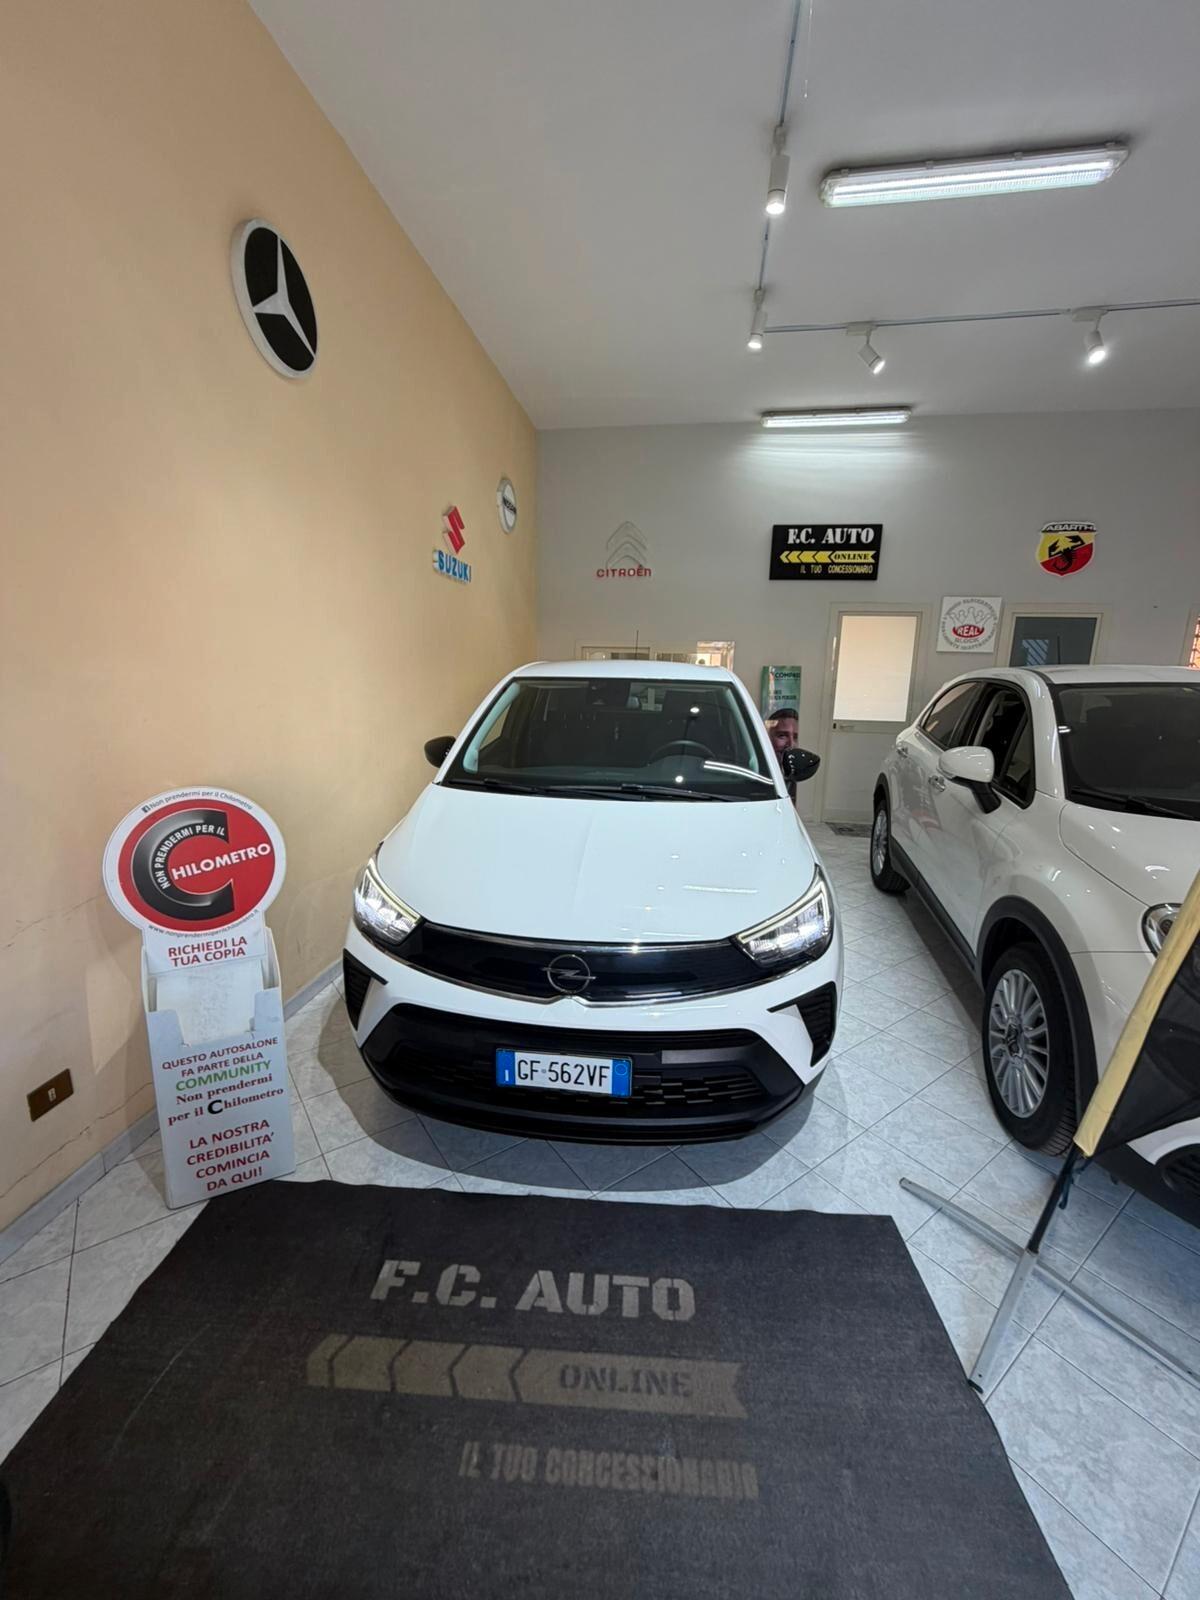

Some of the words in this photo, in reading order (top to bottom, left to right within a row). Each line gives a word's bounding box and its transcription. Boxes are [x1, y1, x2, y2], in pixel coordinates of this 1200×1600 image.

[787, 528, 815, 544] F.C.
[821, 527, 875, 544] AUTO
[437, 549, 471, 583] SUZUKI
[800, 565, 806, 573] IL
[810, 565, 822, 574] TUO
[828, 565, 873, 574] CONCESSIONARIO
[957, 625, 981, 636] REAL
[150, 799, 164, 809] Non
[165, 790, 200, 803] prendermi
[220, 792, 253, 810] Chilometro
[195, 824, 215, 834] PER
[217, 826, 225, 836] IL
[154, 827, 193, 869] PRENDERMI
[154, 870, 171, 889] NON
[168, 938, 227, 958] RICHIEDI
[231, 936, 247, 946] LA
[171, 953, 200, 967] TUA
[204, 947, 246, 962] COPIA
[162, 1053, 207, 1070] QUESTO
[209, 1037, 278, 1059] AUTOSALONE
[181, 1067, 194, 1077] FA
[197, 1060, 230, 1075] PARTE
[232, 1052, 264, 1066] DELLA
[175, 1060, 272, 1092] COMMUNITY
[176, 1092, 203, 1105] Non
[207, 1073, 273, 1101] prendermi
[167, 1111, 191, 1126] per
[194, 1107, 204, 1118] il
[189, 1137, 207, 1150] LA
[211, 1119, 270, 1145] NOSTRA
[196, 1149, 270, 1179] COMINCIA
[207, 1178, 228, 1192] DA
[231, 1165, 263, 1185] QUI!
[369, 1259, 497, 1309] F.C.
[515, 1269, 696, 1321] AUTO
[559, 1365, 693, 1398] ONLINE
[458, 1441, 481, 1479] IL
[490, 1443, 538, 1483] TUO
